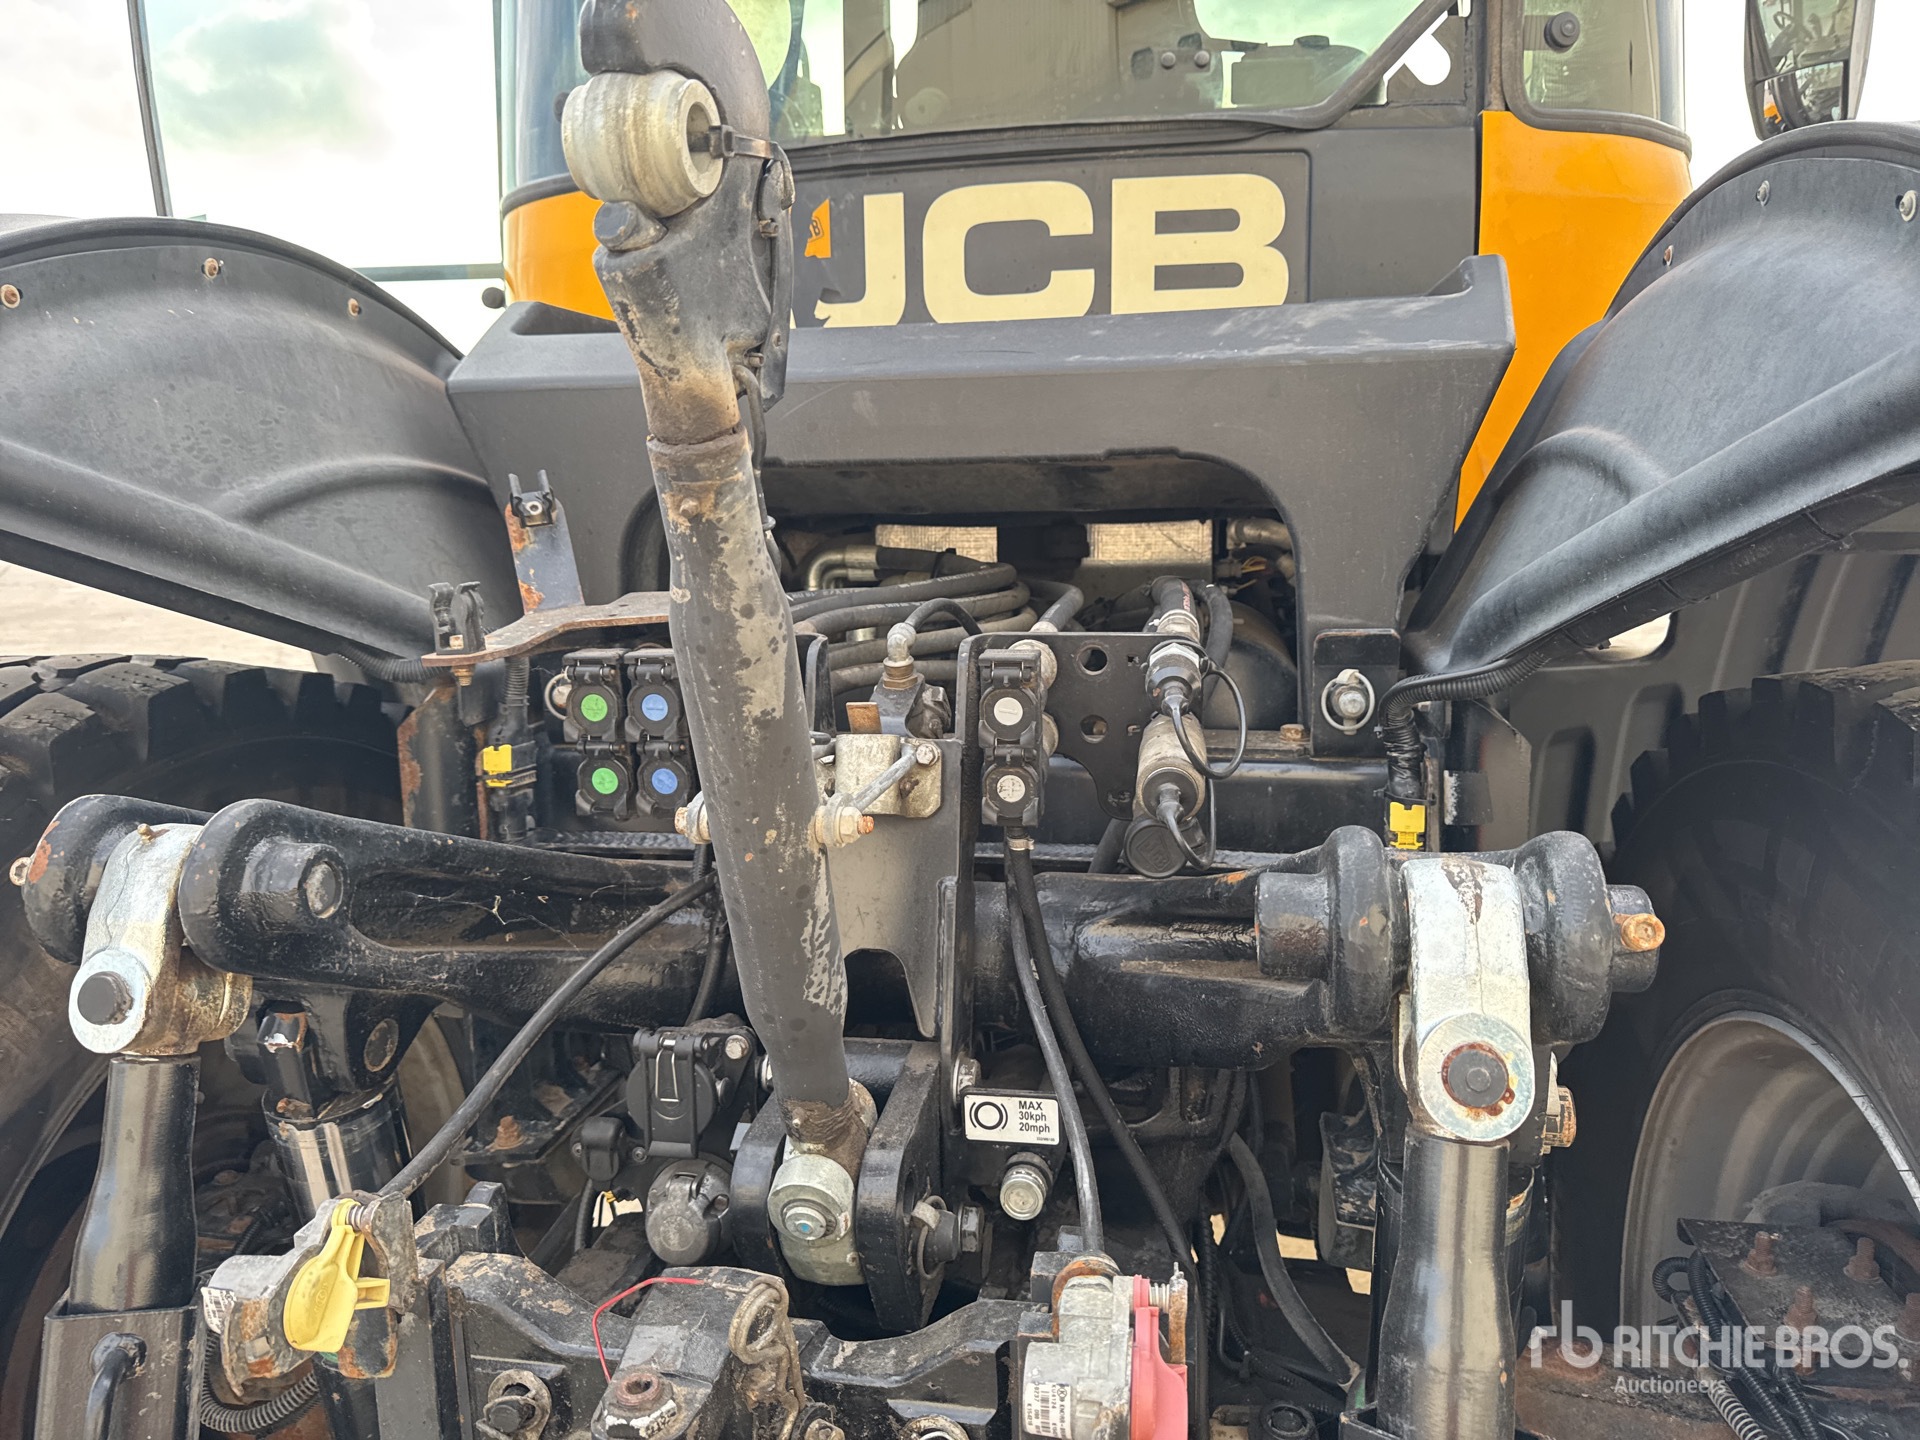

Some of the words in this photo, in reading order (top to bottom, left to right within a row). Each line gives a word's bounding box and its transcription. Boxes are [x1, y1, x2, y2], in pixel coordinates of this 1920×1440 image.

[812, 173, 1289, 329] JCB
[1018, 1100, 1043, 1111] MAX
[1018, 1111, 1047, 1124] 30kph
[1018, 1122, 1050, 1135] 20mph
